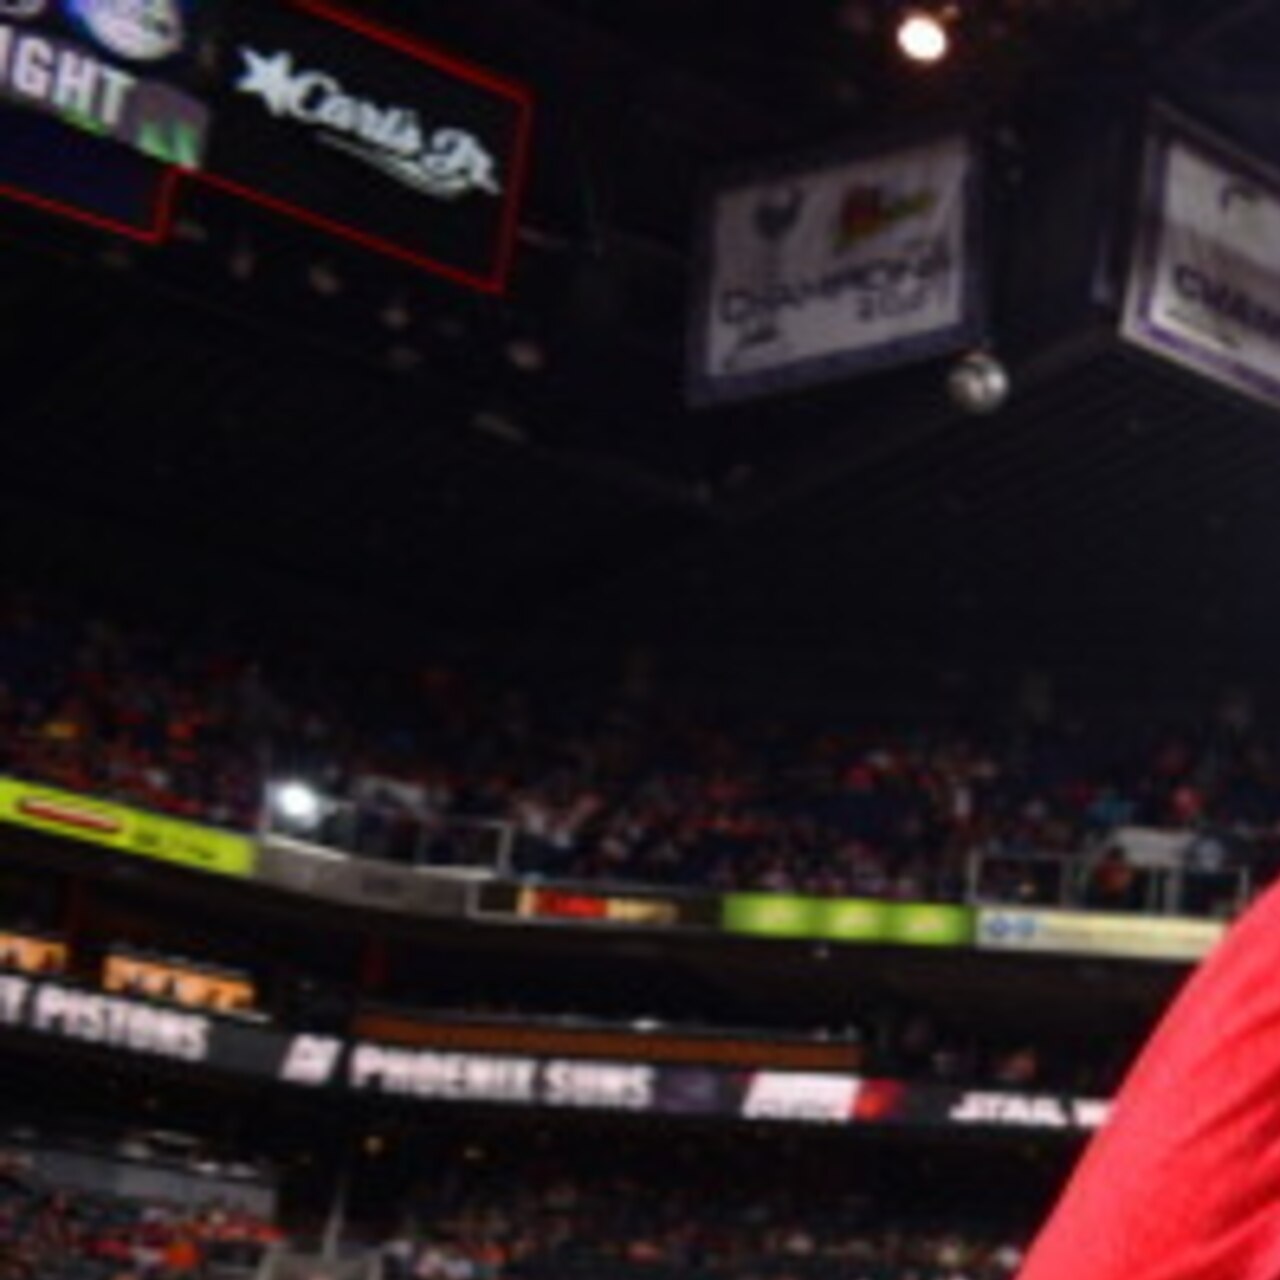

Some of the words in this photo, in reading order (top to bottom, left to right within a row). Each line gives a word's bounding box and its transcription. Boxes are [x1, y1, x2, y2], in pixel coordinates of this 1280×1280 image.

[32, 980, 211, 1062] PISTONS
[351, 1044, 540, 1103] PHOENIX
[542, 1060, 654, 1110] SUNS
